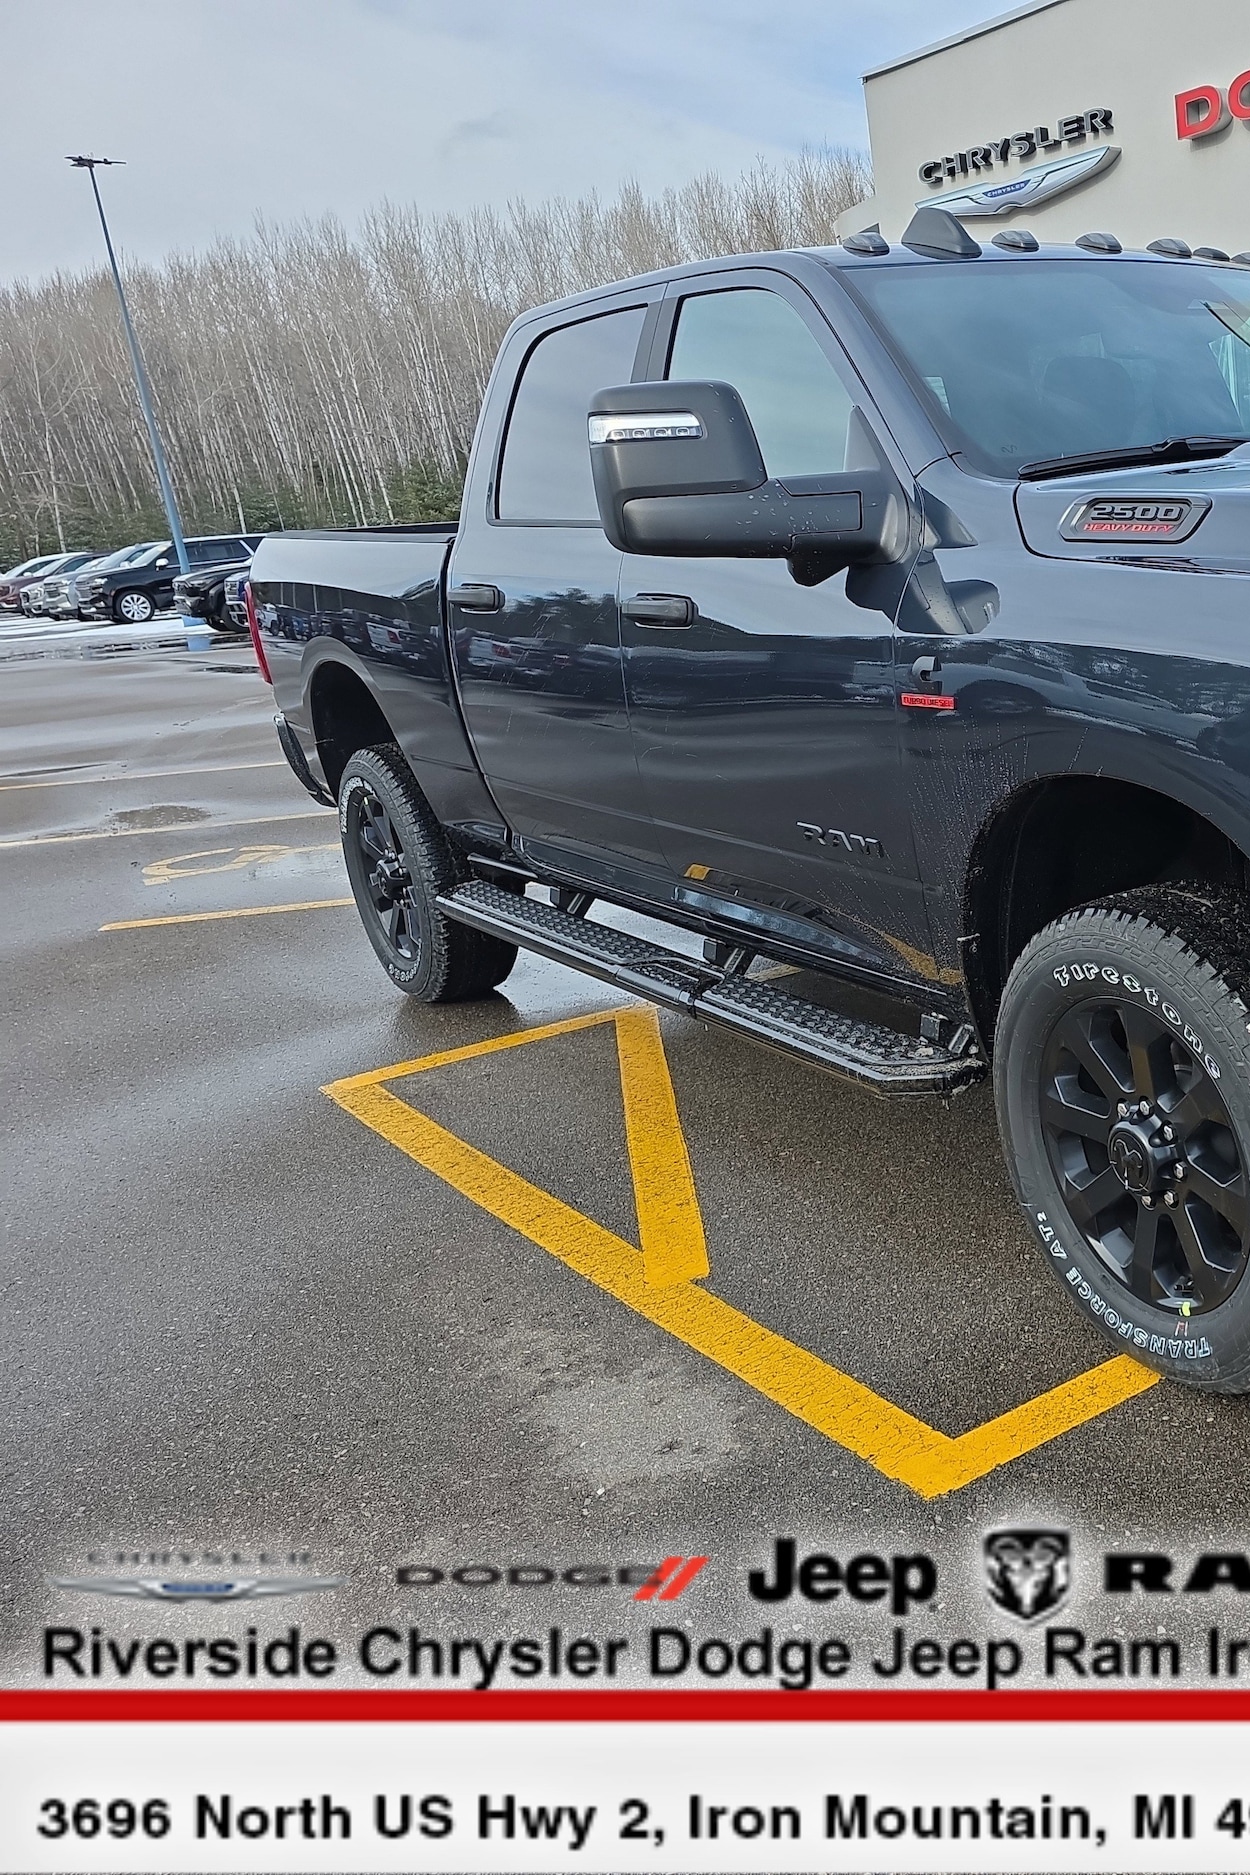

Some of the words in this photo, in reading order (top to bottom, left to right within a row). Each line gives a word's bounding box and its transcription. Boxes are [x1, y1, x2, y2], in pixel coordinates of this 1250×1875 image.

[918, 107, 1113, 185] CHRYSLER
[987, 182, 1025, 197] CHRYSLER
[1091, 506, 1184, 521] 2500
[1132, 524, 1174, 532] DUTY
[796, 821, 885, 858] RAM
[1066, 1266, 1213, 1360] TRANSFORCE
